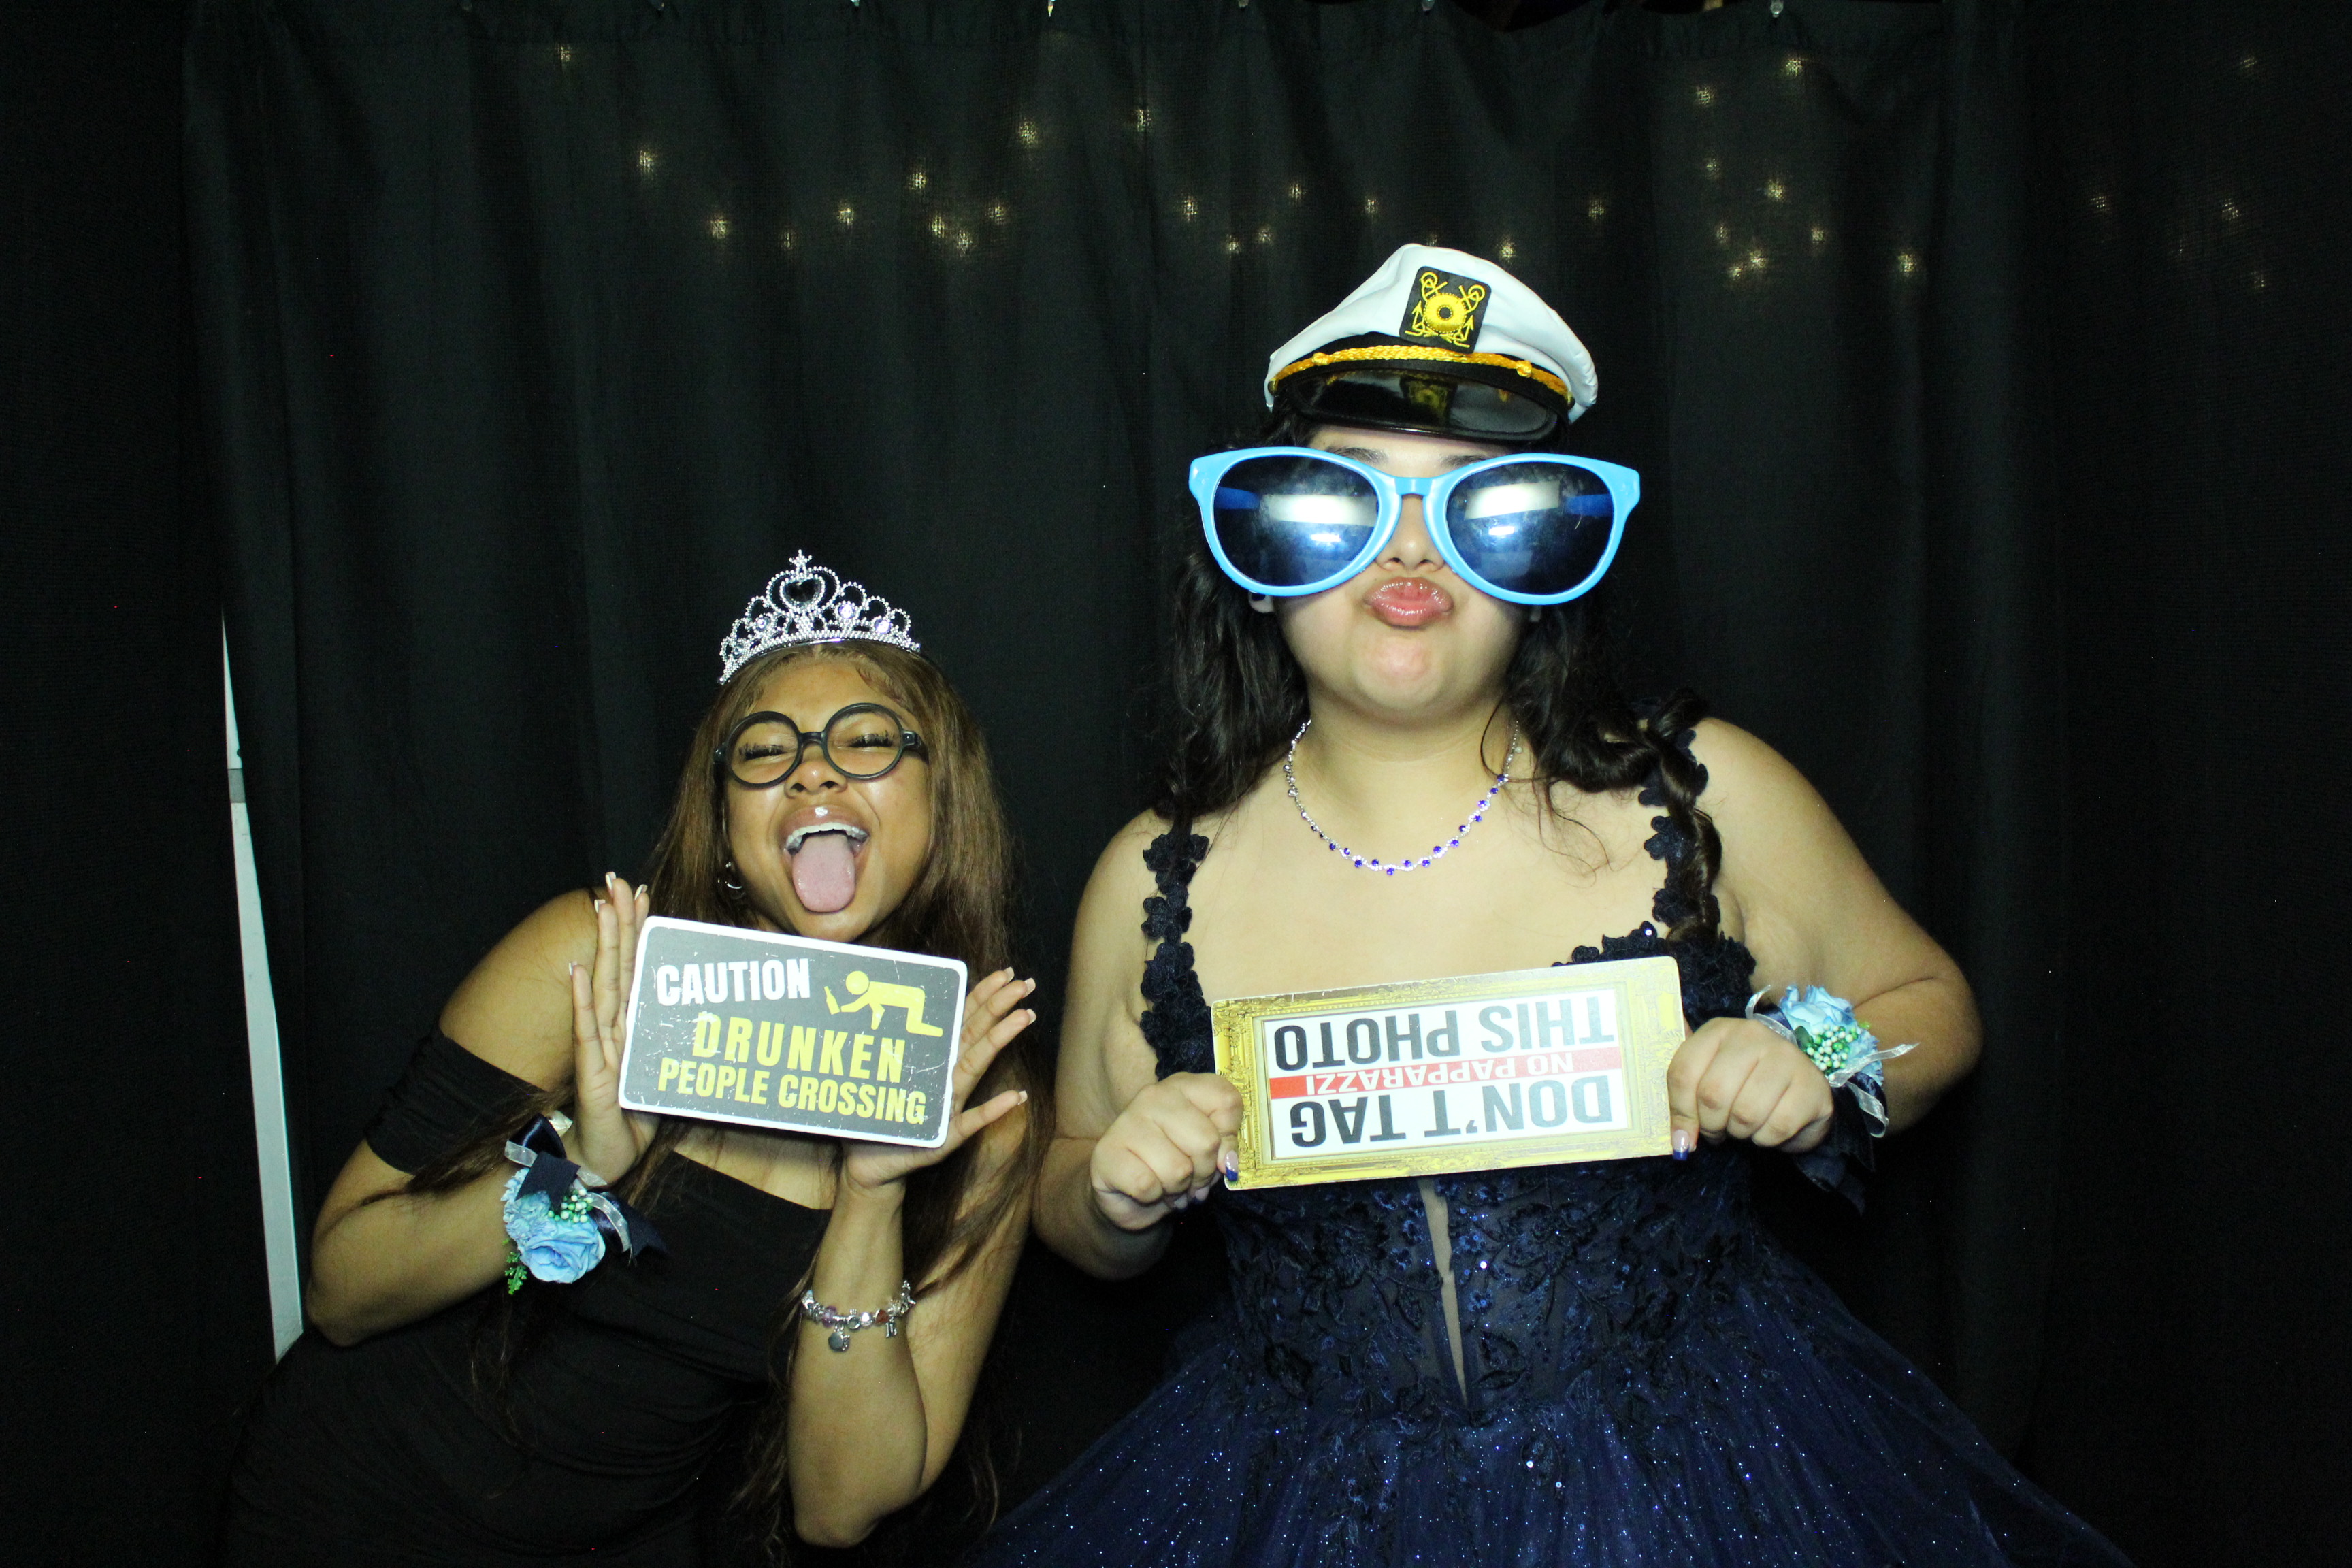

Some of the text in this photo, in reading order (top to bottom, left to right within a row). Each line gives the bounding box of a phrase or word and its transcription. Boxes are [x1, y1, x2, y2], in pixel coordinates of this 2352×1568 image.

[657, 958, 811, 1006] CAUTION
[692, 1012, 905, 1083] DRUNKEN
[1274, 997, 1614, 1071] THIS PHOTO
[657, 1058, 926, 1125] PEOPLE CROSSING
[1306, 1053, 1573, 1095] NO PAPPARAZZI
[1290, 1075, 1612, 1147] DON'T TAG
